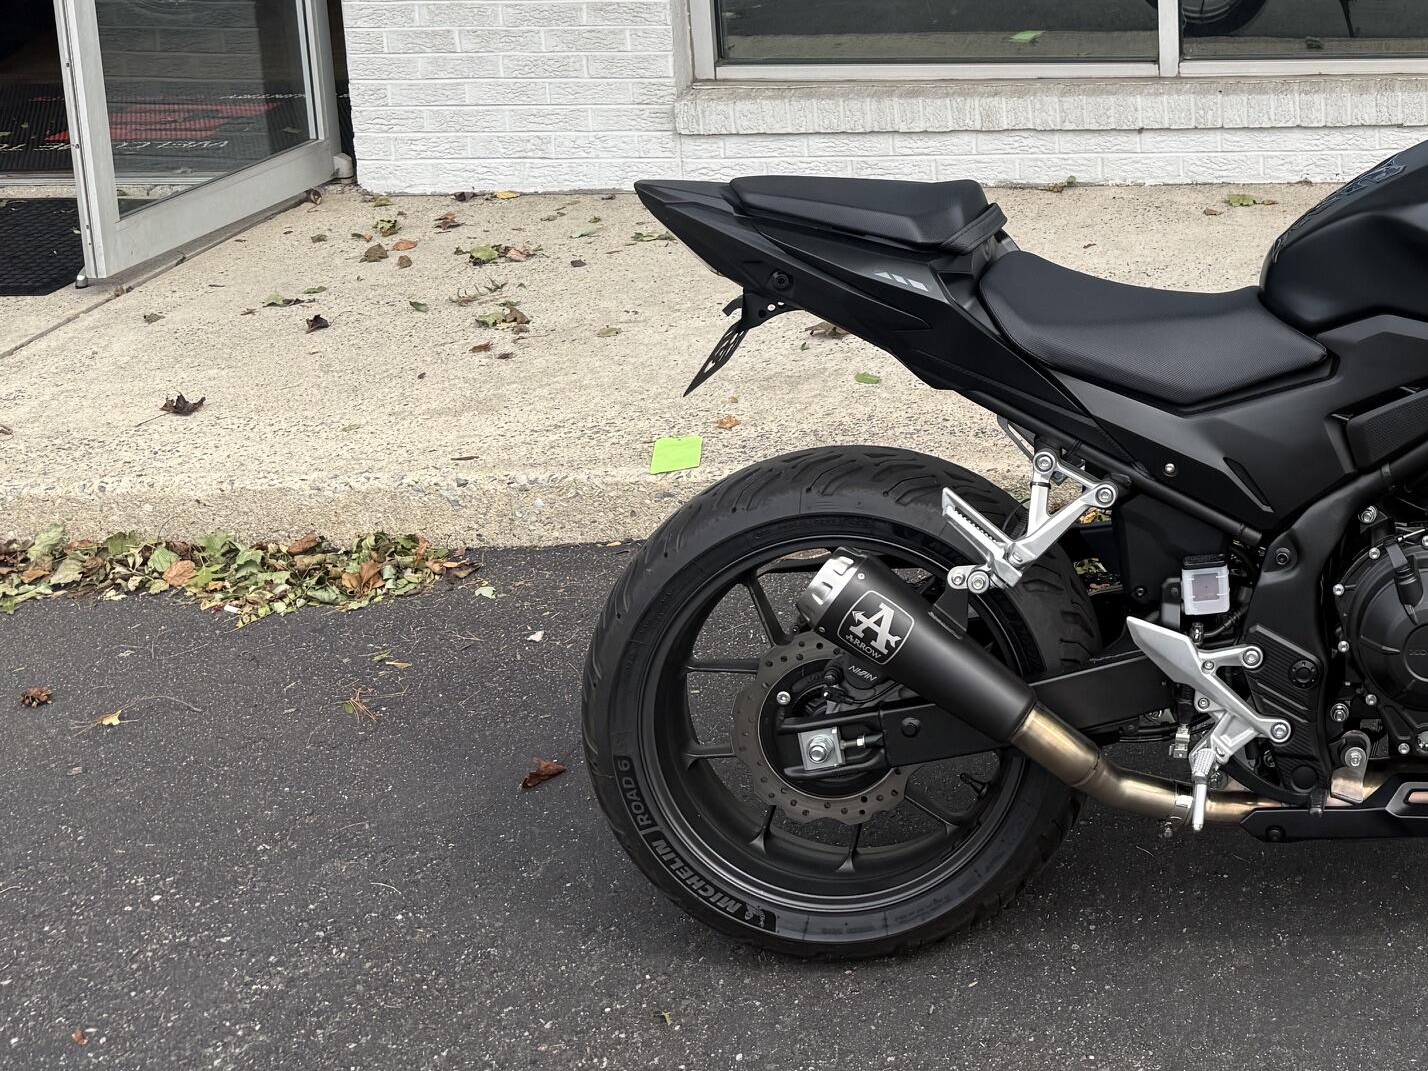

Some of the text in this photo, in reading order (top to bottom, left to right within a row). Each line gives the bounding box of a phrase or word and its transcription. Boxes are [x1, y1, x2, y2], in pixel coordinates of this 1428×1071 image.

[845, 634, 882, 659] ARROW
[617, 758, 743, 914] MICHELIN ROAD 6
